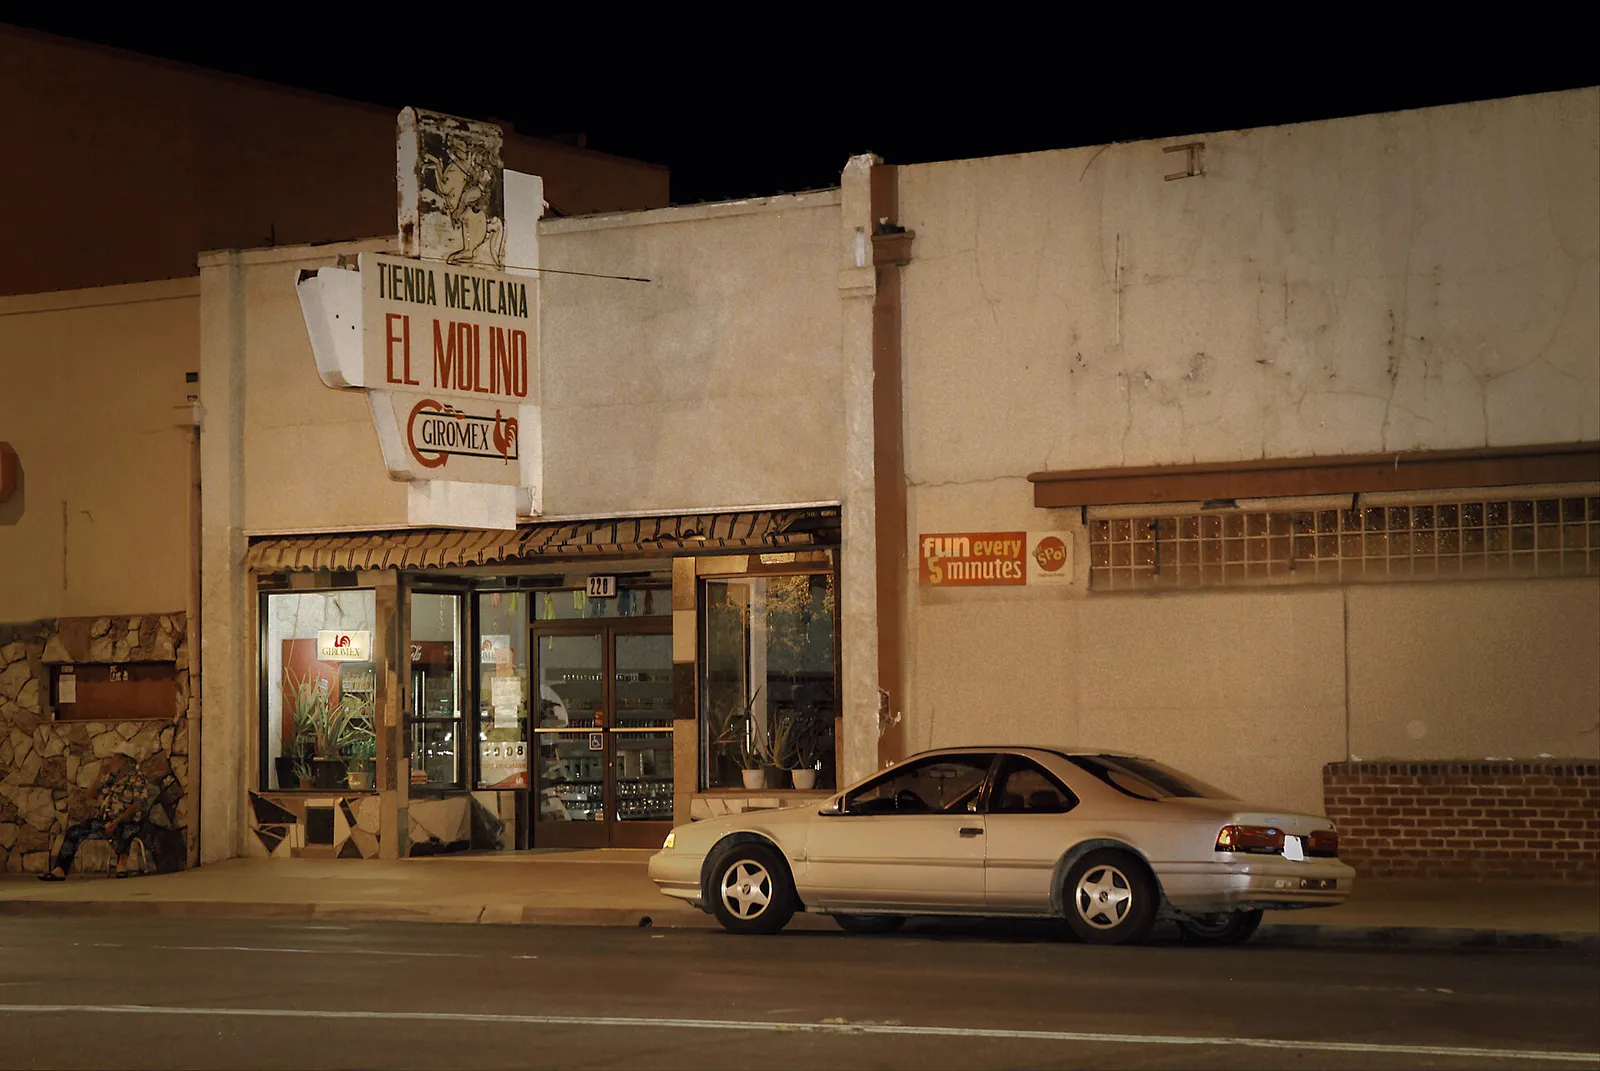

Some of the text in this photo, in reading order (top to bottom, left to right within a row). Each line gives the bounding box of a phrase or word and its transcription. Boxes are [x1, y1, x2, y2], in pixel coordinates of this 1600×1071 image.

[377, 262, 528, 319] TIENDA MEXICANA
[385, 312, 528, 398] EL MOLINO
[422, 419, 489, 450] GIROMEX
[922, 537, 970, 558] fun
[973, 539, 1022, 558] every
[927, 556, 1022, 584] 5 minutes
[590, 577, 608, 595] 220
